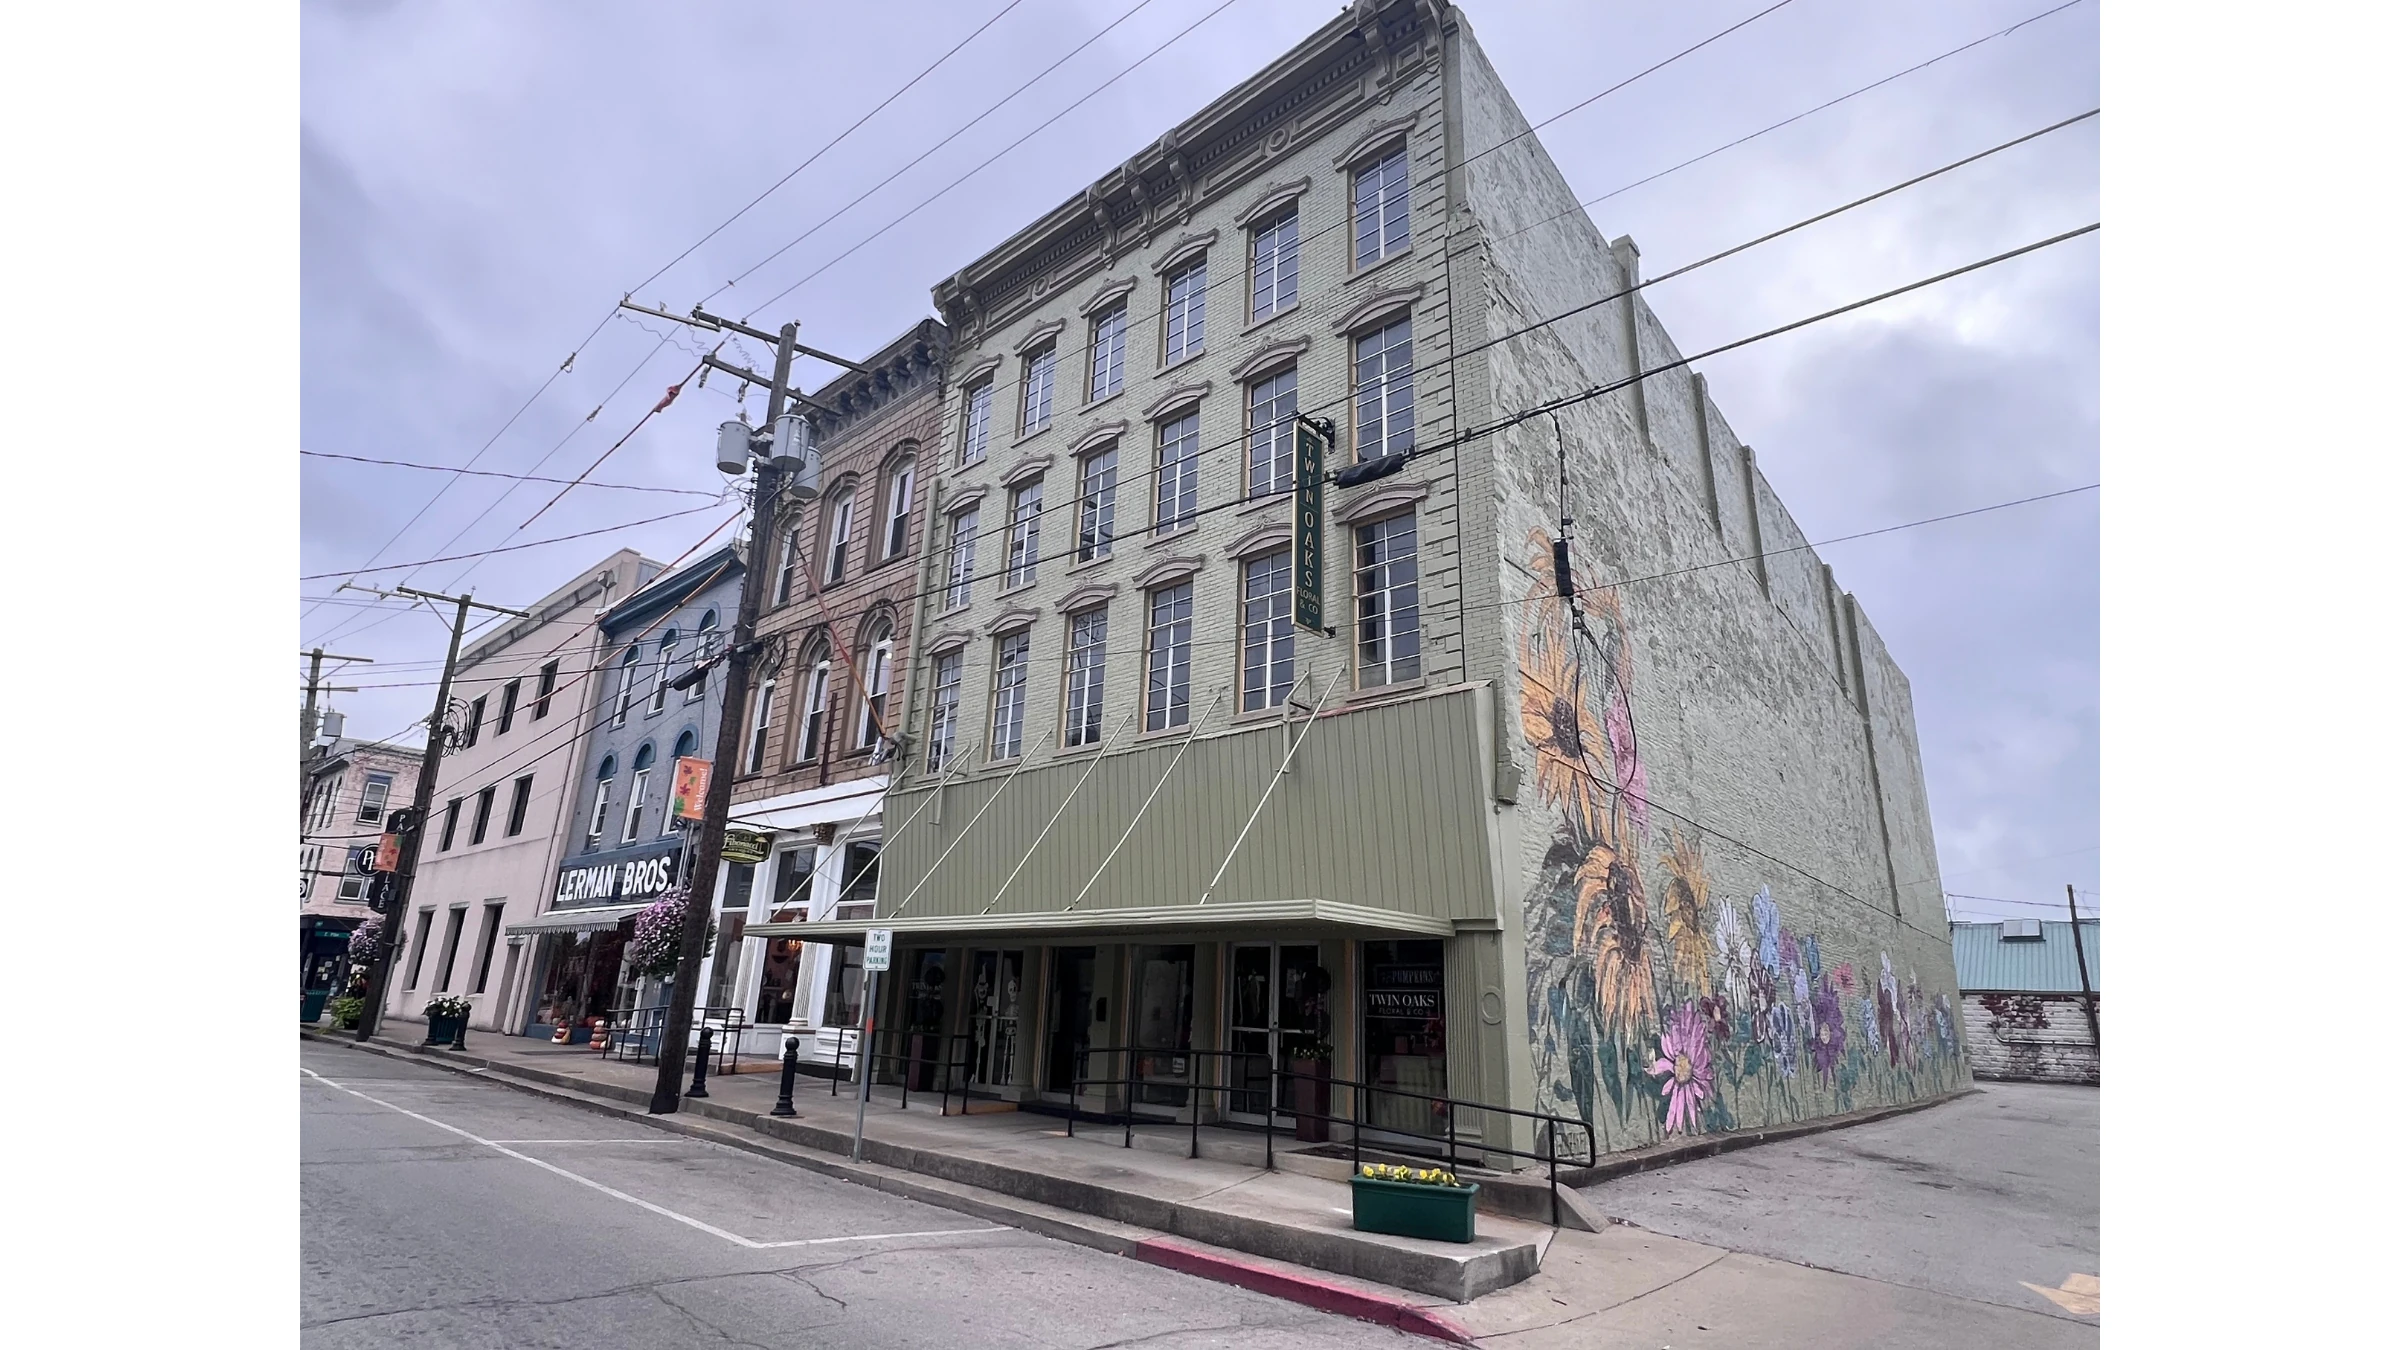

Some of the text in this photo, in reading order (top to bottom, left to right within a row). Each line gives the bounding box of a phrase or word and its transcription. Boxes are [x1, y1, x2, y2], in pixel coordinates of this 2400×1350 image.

[1304, 443, 1315, 588] TWIN OAKS
[1296, 586, 1320, 605] FLORAL
[1308, 604, 1318, 615] CO
[693, 768, 708, 811] Welcome!
[556, 856, 672, 902] LERMAN BROS.
[377, 872, 391, 909] LACE
[873, 933, 885, 942] TWO
[869, 945, 887, 953] HOUR
[866, 956, 887, 965] PARKING
[1392, 969, 1434, 984] PUMPKINS
[1369, 993, 1435, 1007] TWIN OAKS
[1379, 1007, 1405, 1015] FLORAL
[1413, 1008, 1424, 1016] CO
